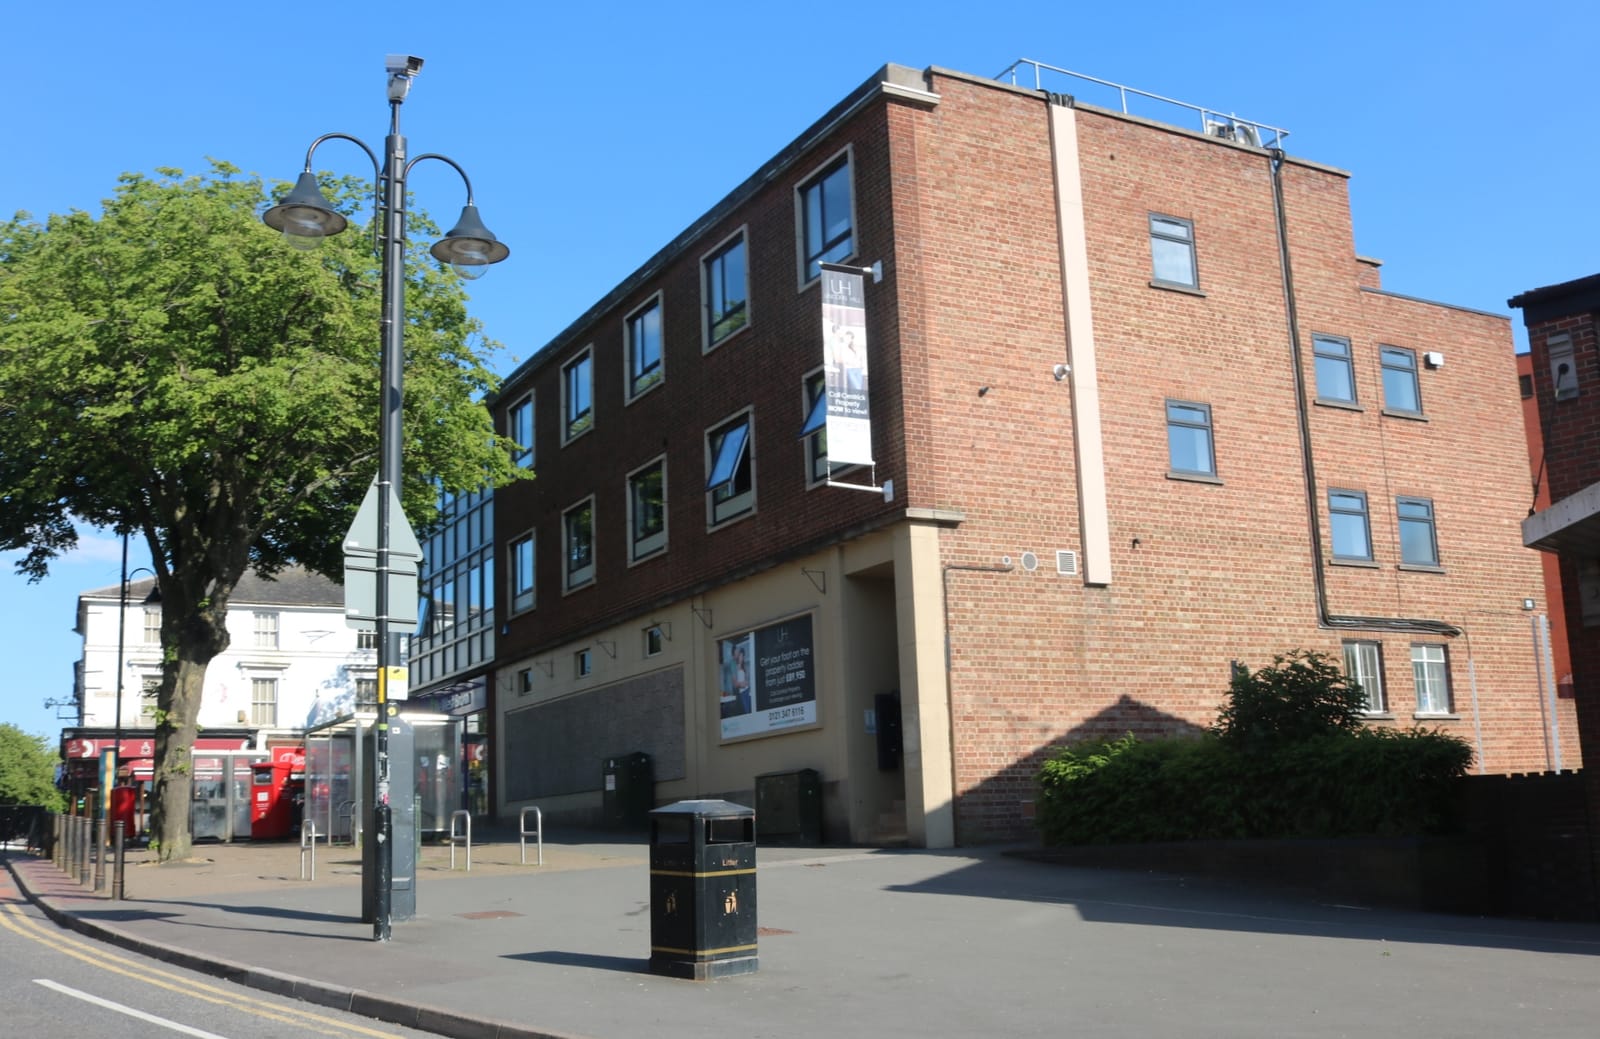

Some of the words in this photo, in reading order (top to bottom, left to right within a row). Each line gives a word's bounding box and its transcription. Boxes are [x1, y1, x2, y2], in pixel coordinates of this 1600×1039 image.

[835, 399, 861, 409] Property
[760, 657, 769, 667] Get
[770, 656, 781, 666] your
[781, 652, 792, 661] foot
[792, 650, 800, 658] on
[800, 647, 809, 656] the
[765, 665, 786, 677] property
[786, 661, 805, 670] ladder
[765, 678, 777, 687] from
[722, 858, 739, 867] Litter
